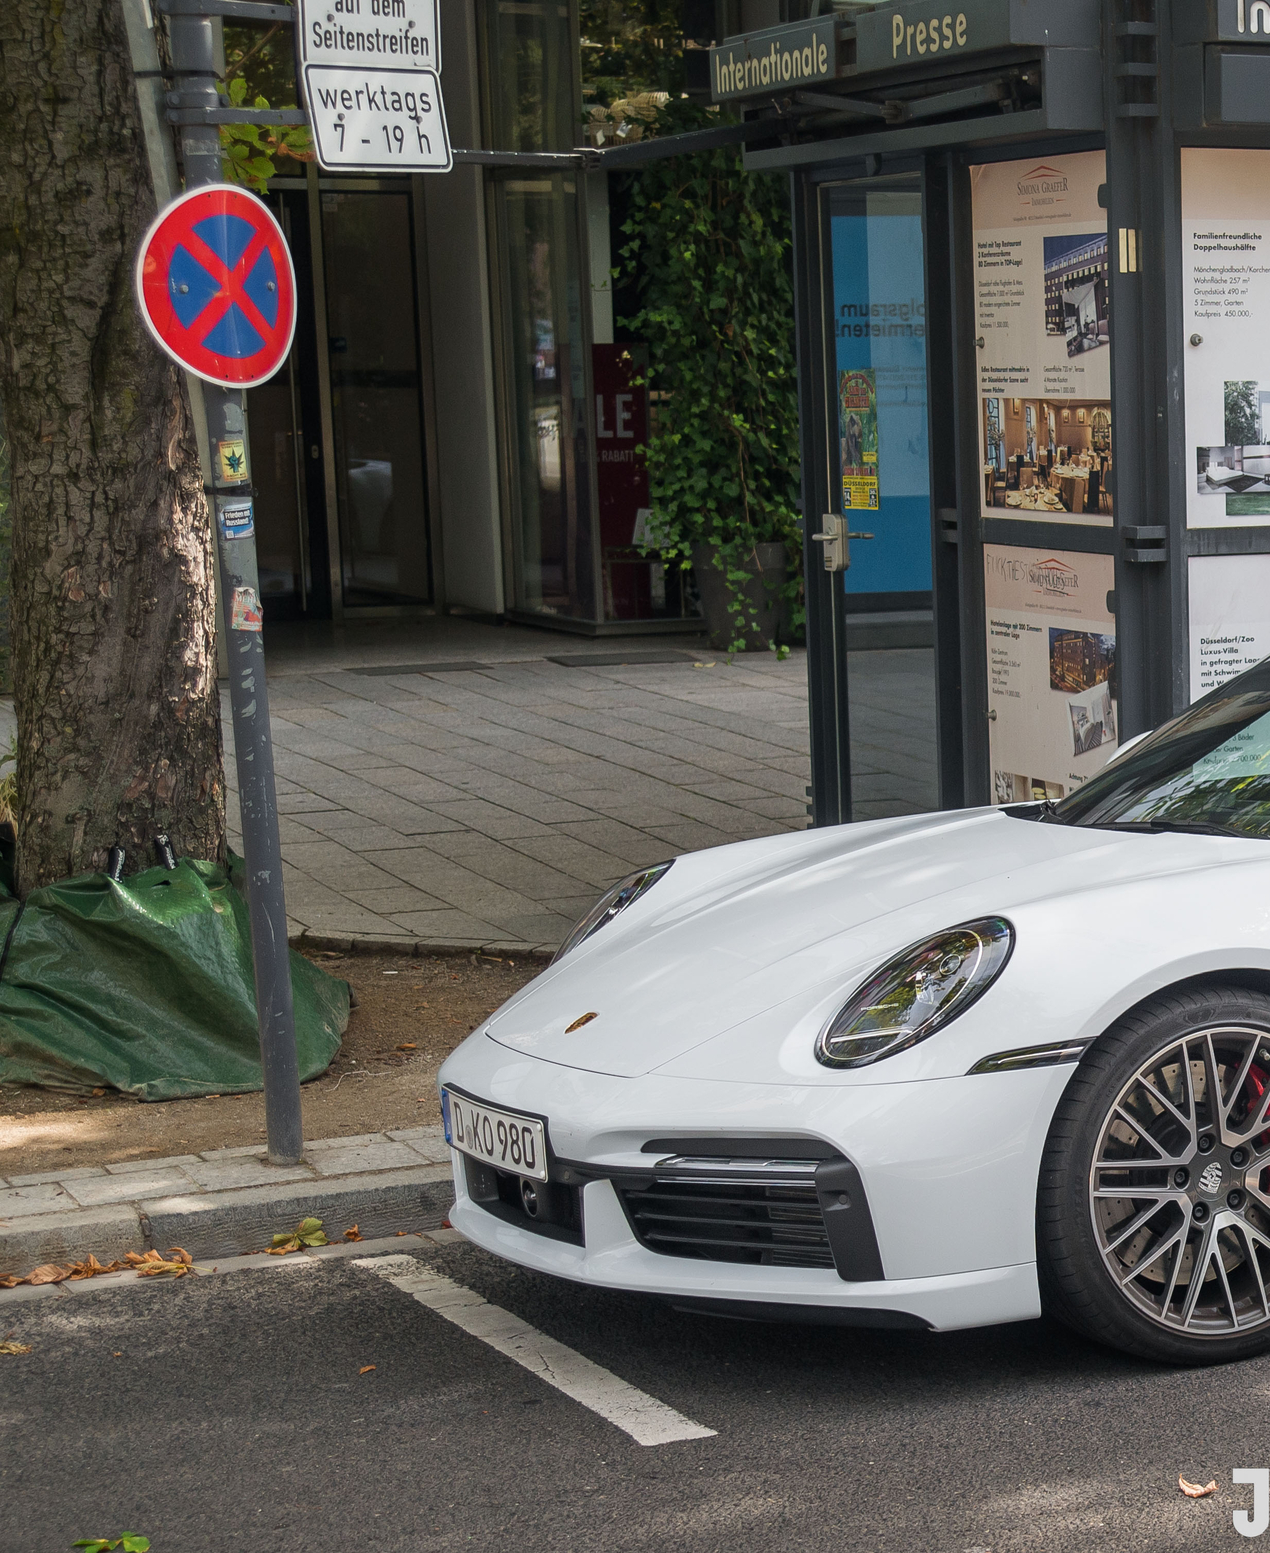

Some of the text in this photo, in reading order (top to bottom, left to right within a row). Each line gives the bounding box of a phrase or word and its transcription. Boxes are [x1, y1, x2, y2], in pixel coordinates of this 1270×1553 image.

[312, 21, 429, 56] Seitenstreifen
[892, 13, 967, 59] Presse
[716, 33, 828, 94] Internationale
[318, 82, 432, 121] werktags
[333, 123, 345, 152] 7
[382, 124, 404, 154] 19
[416, 126, 432, 154] h
[1193, 232, 1263, 240] Familienfreundliche
[1193, 243, 1257, 252] Doppelhaushälfte
[1193, 276, 1229, 285] Wohnfläche
[1242, 276, 1250, 284] m²
[1193, 287, 1249, 297] Grundstück 490 m²
[1200, 298, 1222, 308] Zimmer,
[1224, 299, 1244, 307] Garten
[1194, 309, 1222, 319] Kaufpreis
[601, 450, 634, 463] RABATT
[1200, 636, 1255, 645] Düsseldorf/Zoo
[1200, 647, 1239, 656] Luxus-Villa
[1200, 659, 1208, 667] in
[1209, 658, 1242, 668] gefragter
[1200, 680, 1215, 688] und
[453, 1101, 536, 1170] D KO 980
